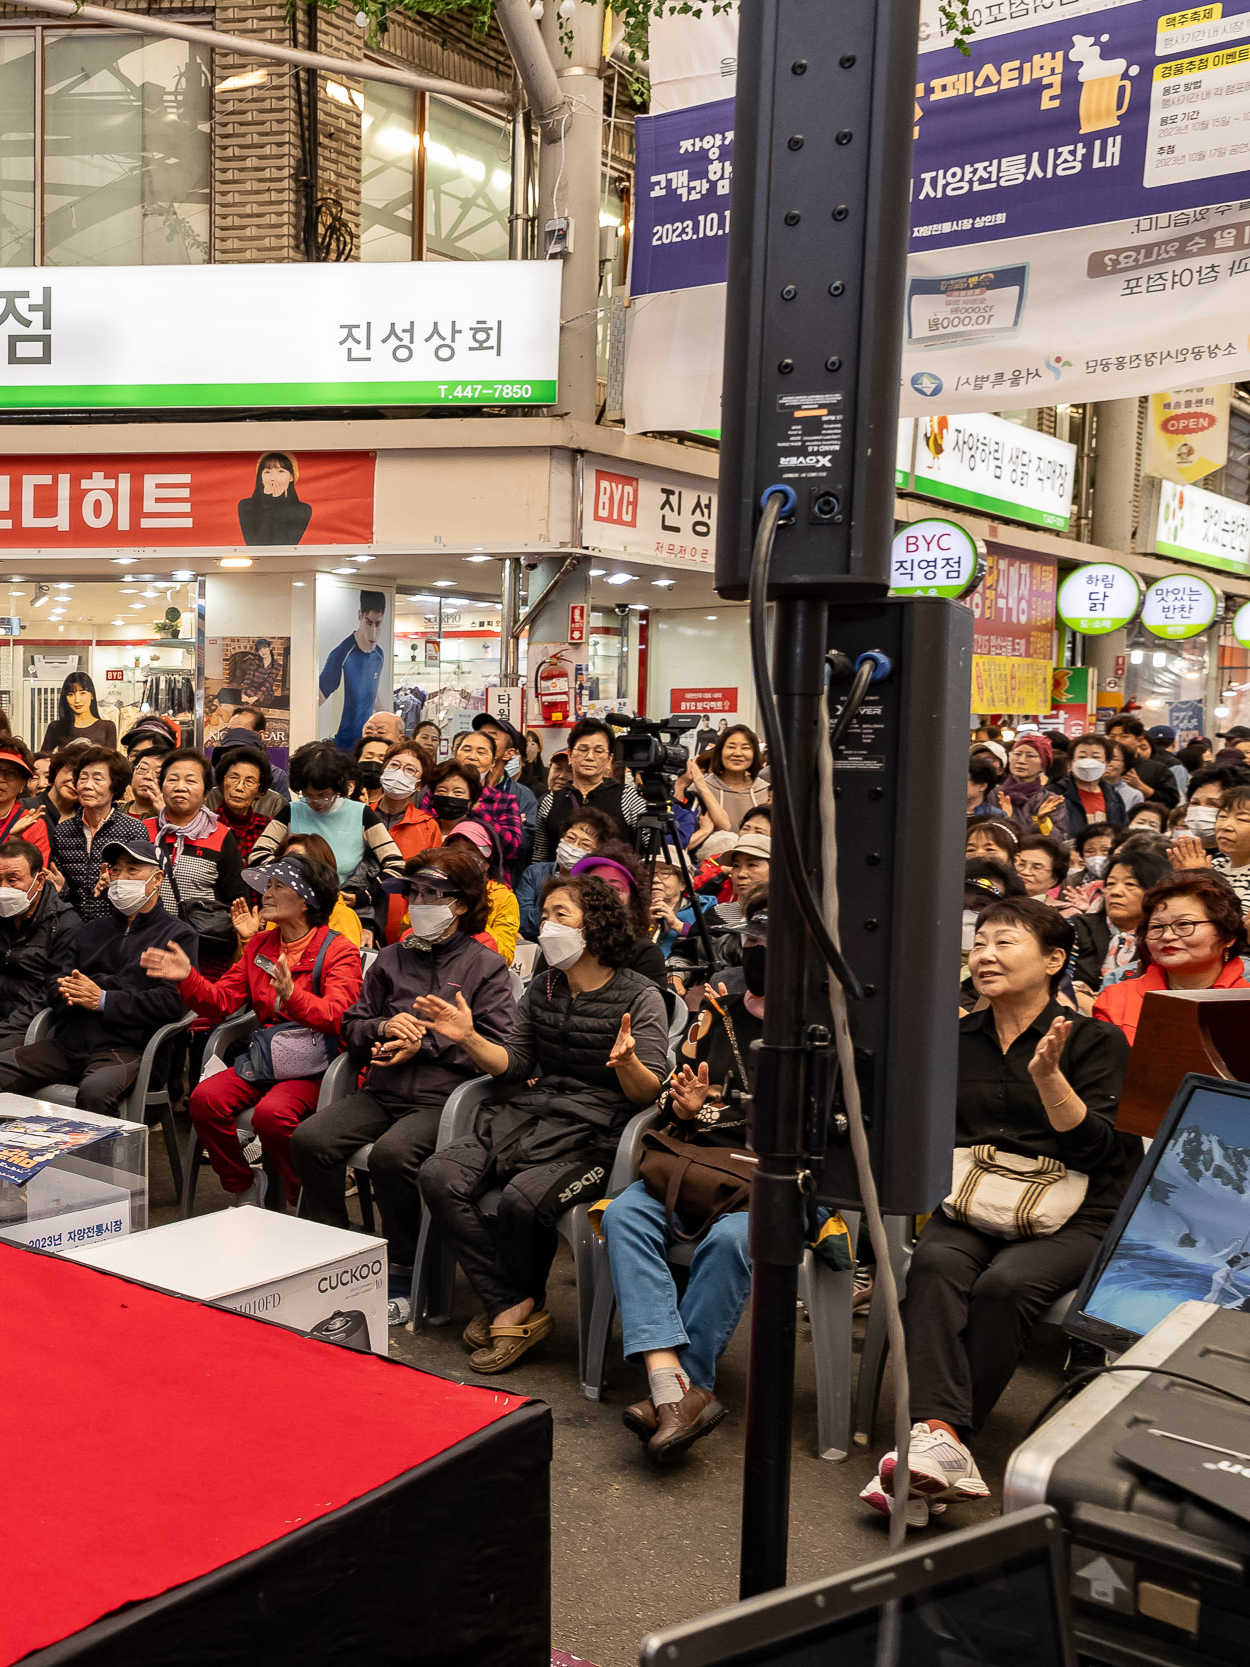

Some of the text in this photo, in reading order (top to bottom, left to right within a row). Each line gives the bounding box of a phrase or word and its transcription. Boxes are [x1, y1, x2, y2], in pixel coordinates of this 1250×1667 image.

[1166, 8, 1214, 27] 맥주축제
[1162, 48, 1250, 78] 경품추첨 이벤트
[930, 51, 1064, 110] 페스티벌
[1181, 110, 1200, 122] 기간
[918, 135, 1122, 200] 자양전통시장 내
[651, 169, 709, 202] 고객과
[974, 212, 1007, 228] 상인회
[338, 318, 504, 363] 진성상회
[437, 384, 532, 400] T.447-7850
[1167, 417, 1209, 431] OPEN
[778, 455, 832, 467] XOVER
[598, 480, 633, 522] BYC
[905, 533, 952, 553] BYC
[894, 556, 962, 581] 직영점
[1086, 574, 1115, 589] 하림
[1088, 591, 1110, 612] 닭
[1155, 587, 1203, 603] 맛있는
[1162, 604, 1194, 619] 반찬
[107, 671, 123, 680] BYC
[67, 1219, 123, 1243] 자양전통시장
[317, 1259, 382, 1294] CUCKOO
